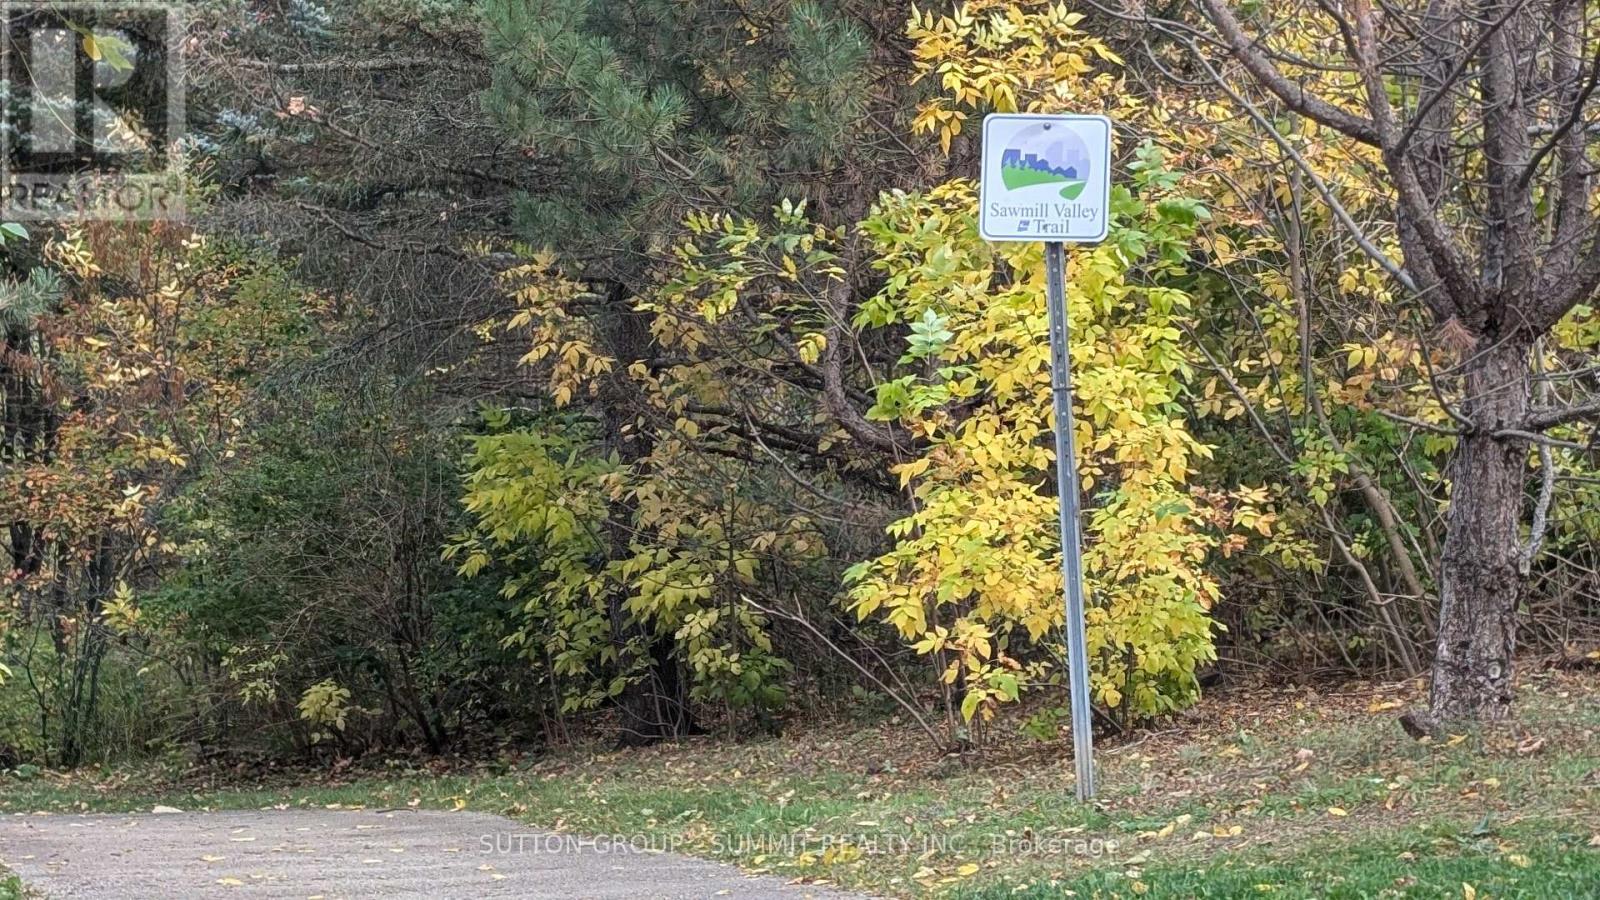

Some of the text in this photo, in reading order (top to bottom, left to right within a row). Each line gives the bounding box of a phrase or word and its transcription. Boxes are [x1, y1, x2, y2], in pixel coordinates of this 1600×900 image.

[990, 201, 1099, 222] Sawmill Valley
[1033, 218, 1070, 234] Trail
